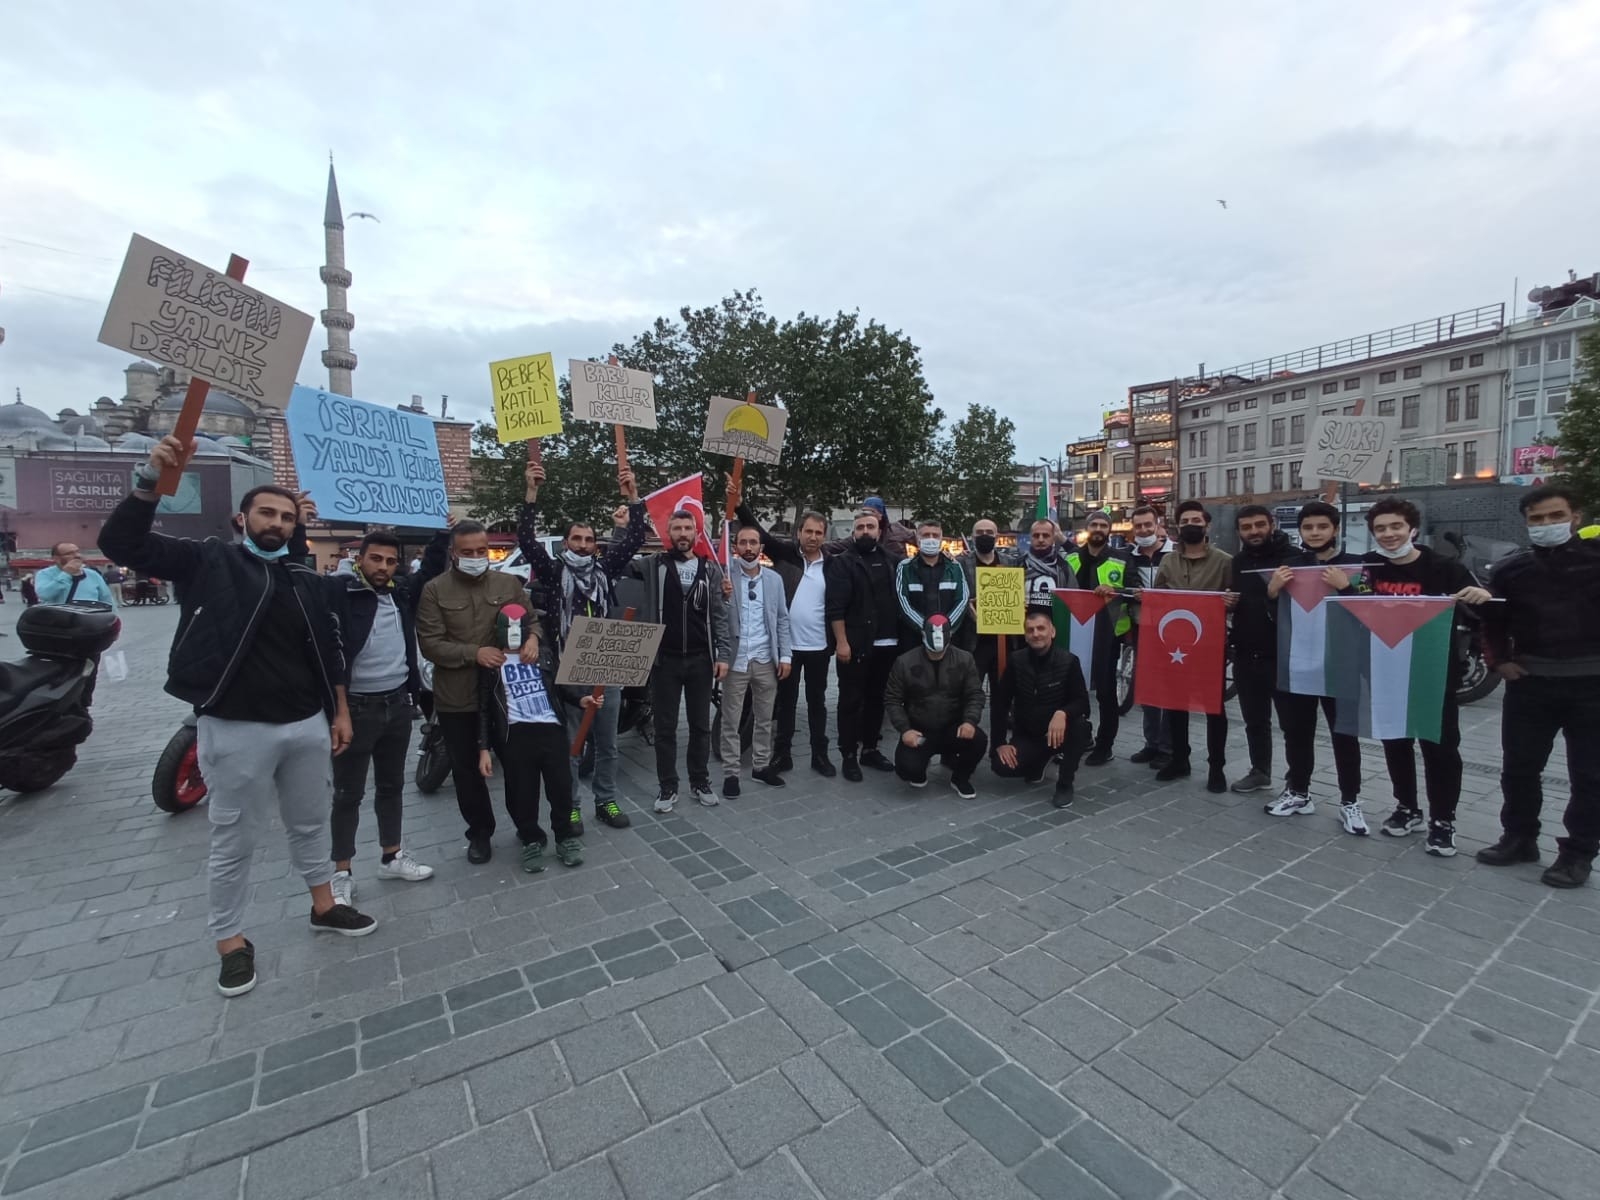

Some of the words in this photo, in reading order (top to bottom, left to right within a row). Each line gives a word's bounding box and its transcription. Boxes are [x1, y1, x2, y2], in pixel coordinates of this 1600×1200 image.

[150, 300, 267, 367] YALNIZ
[497, 360, 551, 391] BEBEK
[584, 363, 629, 385] BABY
[597, 383, 651, 409] KILLER
[589, 401, 641, 424] ISRAEL
[1316, 453, 1373, 480] 227
[55, 485, 65, 495] 2
[68, 485, 122, 496] ASIRLIK
[334, 477, 448, 518] SORUNDUR
